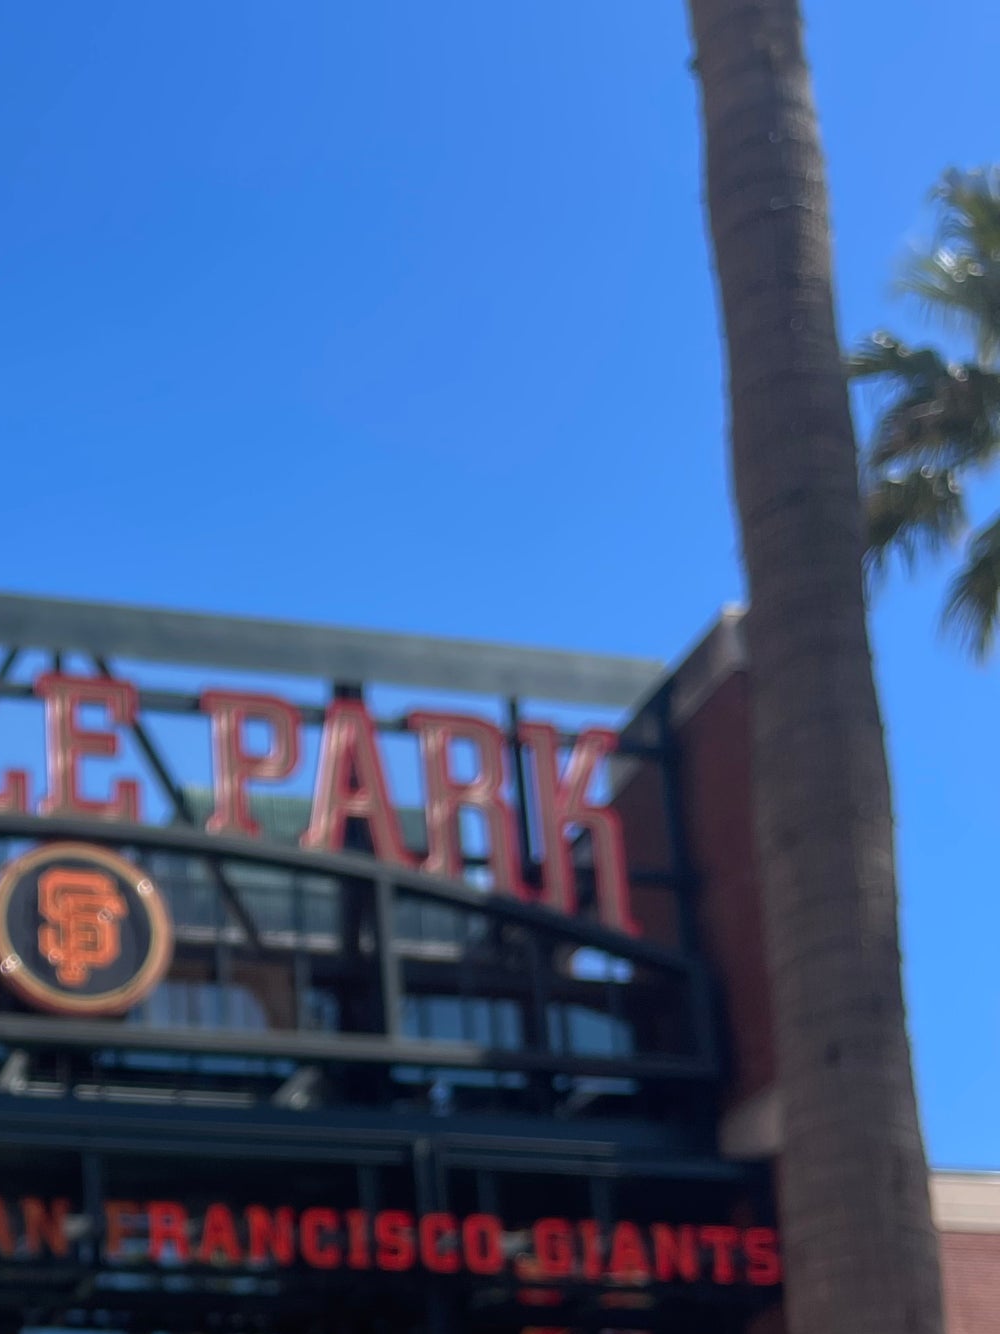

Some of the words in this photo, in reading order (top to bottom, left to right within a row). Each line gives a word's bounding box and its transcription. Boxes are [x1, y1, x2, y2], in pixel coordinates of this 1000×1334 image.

[200, 690, 638, 934] PARK
[106, 1199, 502, 1275] FRANCISCO
[530, 1216, 783, 1287] GIANTS
